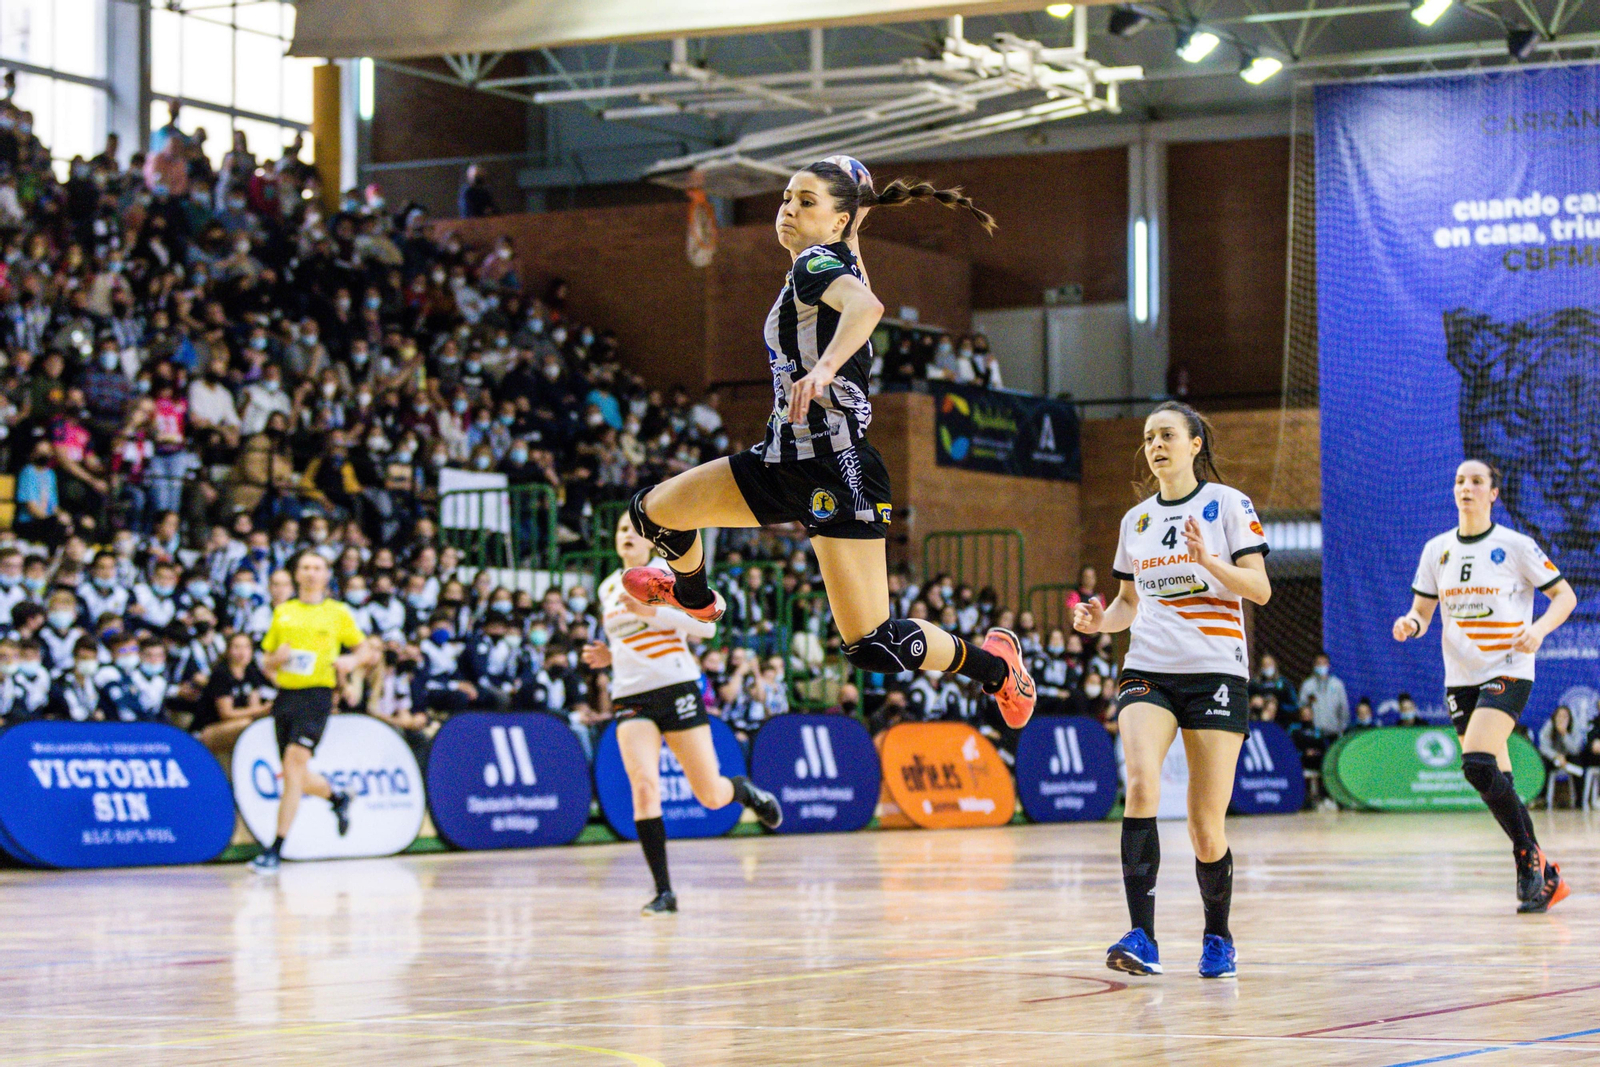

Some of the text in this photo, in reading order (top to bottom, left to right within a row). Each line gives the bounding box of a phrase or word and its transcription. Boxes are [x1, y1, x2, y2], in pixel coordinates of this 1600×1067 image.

[1453, 190, 1600, 222] cuando ca
[1433, 227, 1471, 248] en
[1474, 222, 1547, 246] casa,
[1161, 525, 1178, 550] 4
[1157, 573, 1197, 590] promet
[1460, 563, 1472, 582] 6
[1445, 586, 1500, 597] BEKAMENT
[675, 693, 697, 714] 22
[1212, 683, 1230, 707] 4
[28, 759, 190, 789] VICTORIA
[91, 793, 151, 822] SIN
